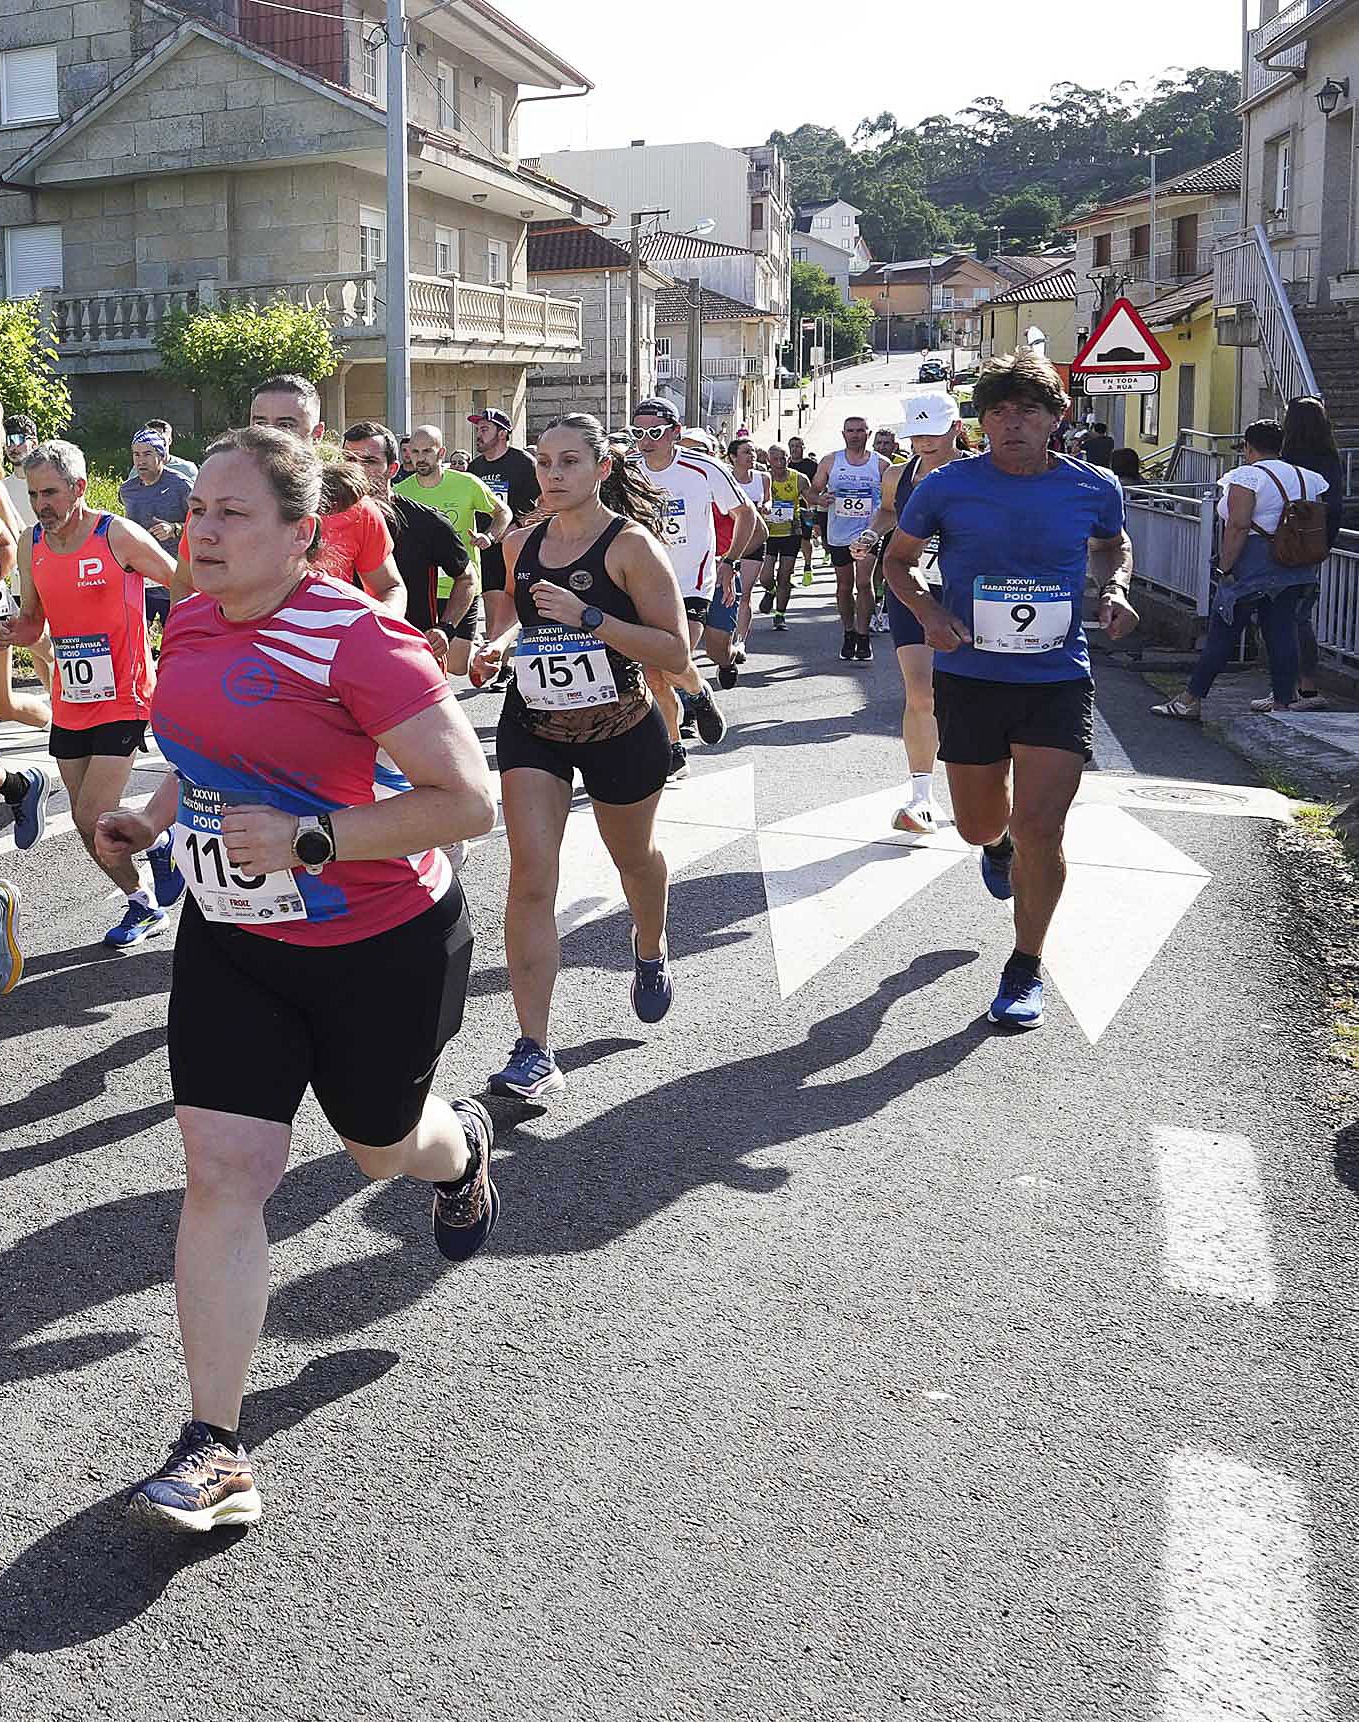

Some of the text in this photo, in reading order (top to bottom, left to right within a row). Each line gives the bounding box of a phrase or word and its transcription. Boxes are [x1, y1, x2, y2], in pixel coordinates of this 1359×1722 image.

[843, 498, 864, 510] 86
[982, 584, 1019, 592] MARATÓN
[1028, 584, 1061, 593] FÁTIMA
[1010, 603, 1037, 632] 9
[537, 627, 562, 635] XXXVII
[522, 635, 550, 644] RATÓN
[538, 644, 564, 653] POIO
[63, 659, 93, 685] 10
[529, 653, 596, 688] 151
[192, 787, 220, 802] XXXVII
[204, 805, 214, 814] DE
[193, 814, 221, 831] POIO
